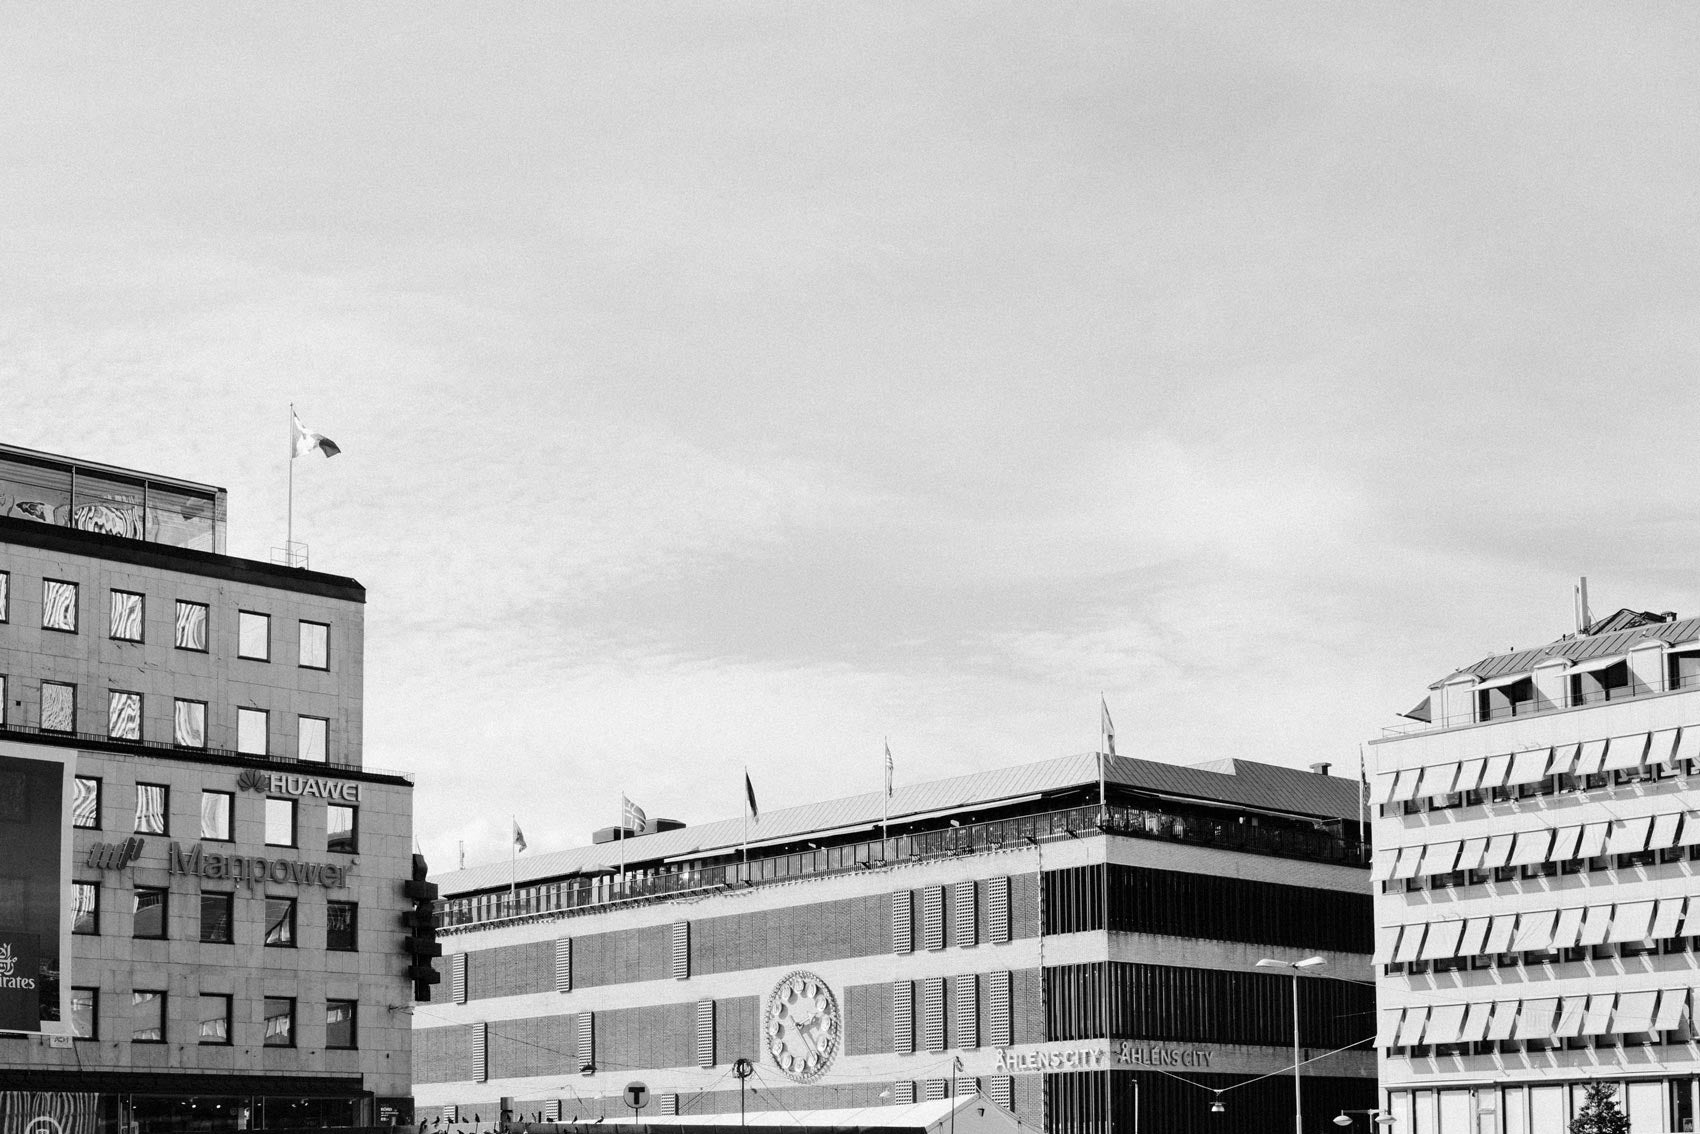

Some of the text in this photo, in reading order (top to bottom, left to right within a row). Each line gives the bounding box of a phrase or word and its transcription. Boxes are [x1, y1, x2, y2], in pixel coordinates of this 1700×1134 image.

[269, 774, 362, 801] HUAWEI
[169, 841, 353, 889] Manpower
[1064, 1048, 1101, 1069] CITY
[1119, 1042, 1214, 1067] ÅHLÉNS CITY
[628, 1087, 645, 1105] T
